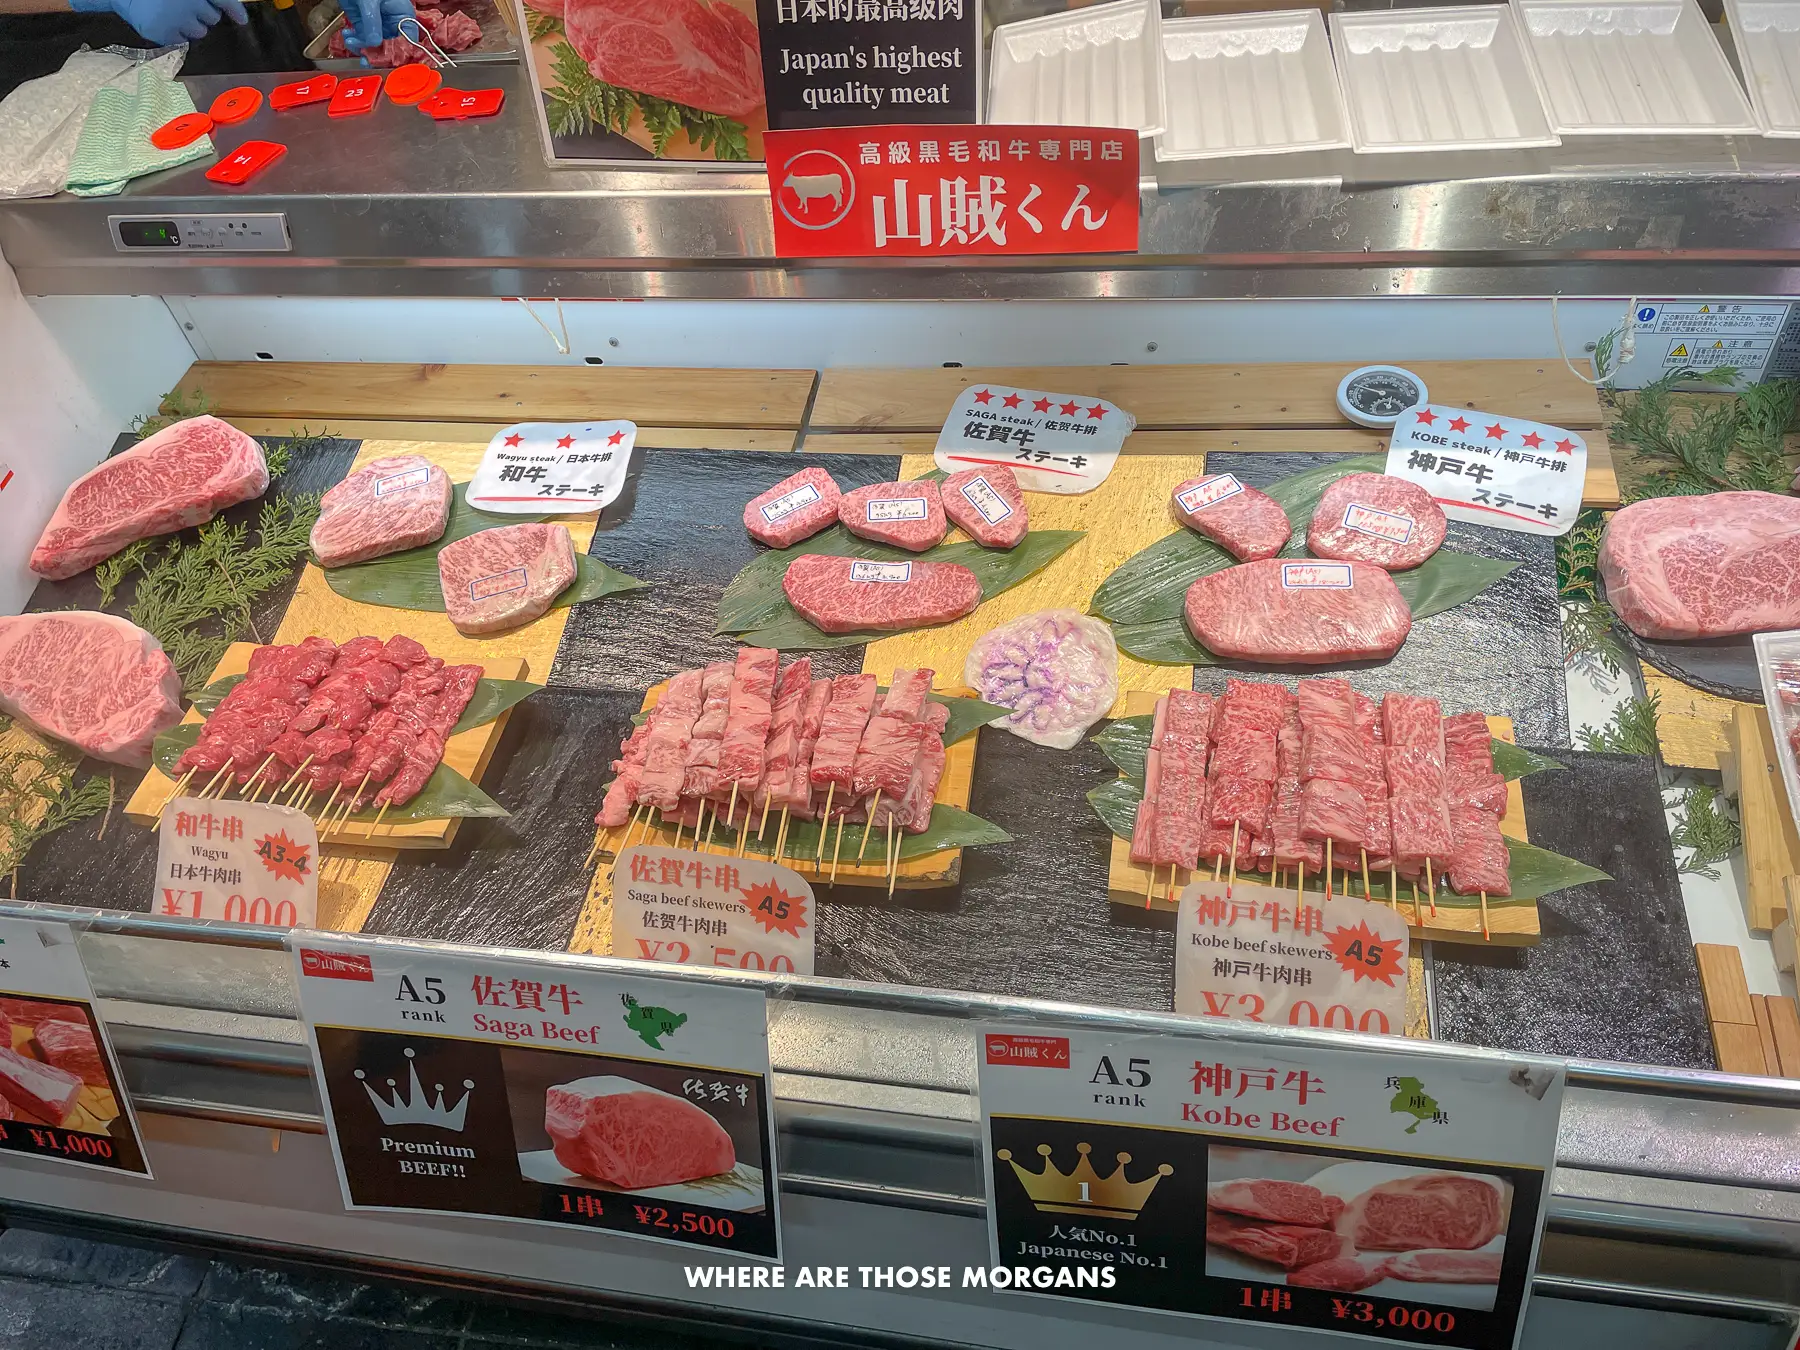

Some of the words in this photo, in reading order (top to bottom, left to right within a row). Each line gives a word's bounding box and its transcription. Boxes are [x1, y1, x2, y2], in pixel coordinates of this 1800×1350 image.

[780, 45, 867, 75] Japan's
[873, 45, 962, 75] highest
[345, 88, 364, 98] 23
[460, 96, 476, 108] 15
[803, 81, 884, 110] quality
[890, 83, 949, 104] meat
[859, 140, 1124, 165] 高級黒毛和牛専門店
[872, 175, 1109, 248] 山賊くん
[965, 409, 997, 421] SAGA
[1001, 415, 1034, 426] steak
[963, 421, 1035, 447] 佐賀牛
[1411, 431, 1448, 446] KOBE
[1452, 440, 1491, 456] steak
[497, 453, 527, 463] Wagyu
[566, 452, 613, 464] 日本牛排
[1015, 448, 1087, 469] ステーキ
[1407, 450, 1494, 485] 神戸牛
[499, 465, 547, 483] 和牛
[538, 484, 604, 497] ステーキ
[1472, 488, 1558, 519] ステーキ
[175, 811, 244, 842] 和牛串
[191, 845, 229, 861] Wagyu
[258, 841, 307, 873] A3-4
[170, 863, 242, 886] 日本牛肉串
[629, 853, 741, 893] 佐賀牛串
[627, 889, 657, 904] Saga
[661, 892, 691, 907] beef
[693, 896, 746, 914] skewers
[758, 895, 791, 920] A5
[642, 911, 728, 937] 佐贺牛肉串
[1196, 894, 1324, 937] 神戸牛串
[1191, 933, 1230, 949] Kobe
[1234, 937, 1268, 953] beef
[1269, 941, 1333, 960] skewers
[1345, 940, 1383, 966] A5
[395, 974, 447, 1004] A5
[470, 975, 584, 1016] 佐賀牛
[401, 1009, 447, 1024] rank
[473, 1013, 535, 1040] Saga
[541, 1021, 601, 1045] Beef
[1010, 1046, 1067, 1060] 山賊くん
[1089, 1055, 1152, 1088] A5
[1188, 1060, 1327, 1106] 神戸牛
[1093, 1092, 1147, 1108] rank
[1181, 1102, 1261, 1130] Kobe
[1270, 1112, 1345, 1137] Beef
[28, 1129, 112, 1158] ¥1,000
[380, 1137, 476, 1159] Premium
[399, 1160, 466, 1178] BEEF!!
[1077, 1182, 1093, 1203] 1
[559, 1195, 604, 1217] 1串
[634, 1205, 735, 1239] ¥2,500
[1049, 1224, 1138, 1247] 人気No.1
[1017, 1241, 1115, 1262] Japanese
[1120, 1251, 1169, 1269] No.1
[1239, 1287, 1292, 1312] 1串
[1331, 1298, 1456, 1333] ¥3,000
